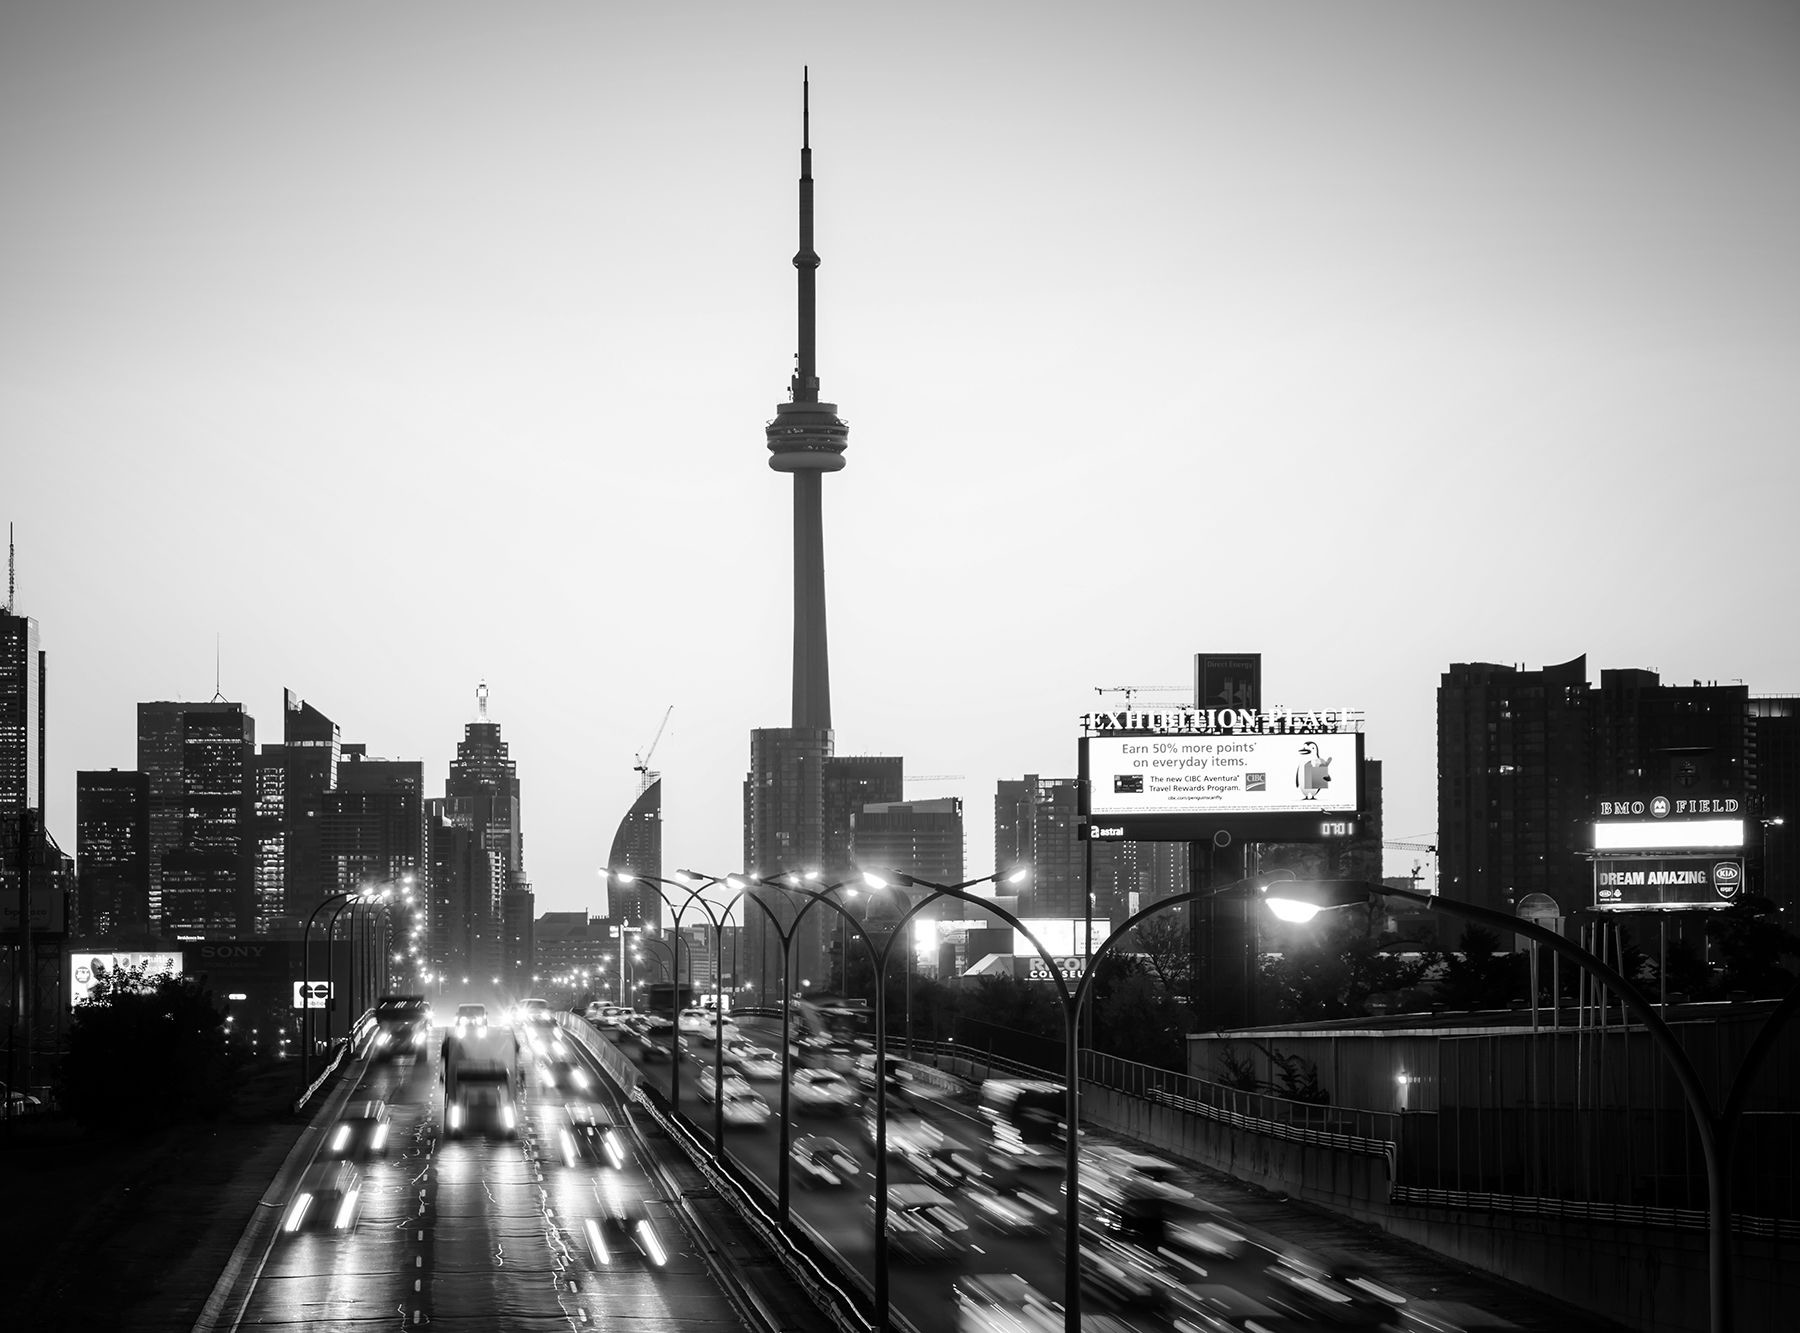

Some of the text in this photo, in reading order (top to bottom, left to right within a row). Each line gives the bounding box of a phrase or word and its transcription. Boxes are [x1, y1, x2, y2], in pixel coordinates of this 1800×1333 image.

[1089, 707, 1356, 729] EXHIBITION PLACE
[1122, 744, 1148, 754] Earn
[1153, 743, 1178, 753] 50%
[1182, 744, 1212, 752] more
[1134, 756, 1248, 769] on everyday items.
[1246, 774, 1265, 782] CIBC
[1207, 784, 1241, 793] Program.
[1601, 799, 1738, 815] BMO FIELD
[1100, 828, 1124, 836] astral
[1600, 872, 1644, 886] DREAM
[201, 946, 264, 958] SONY
